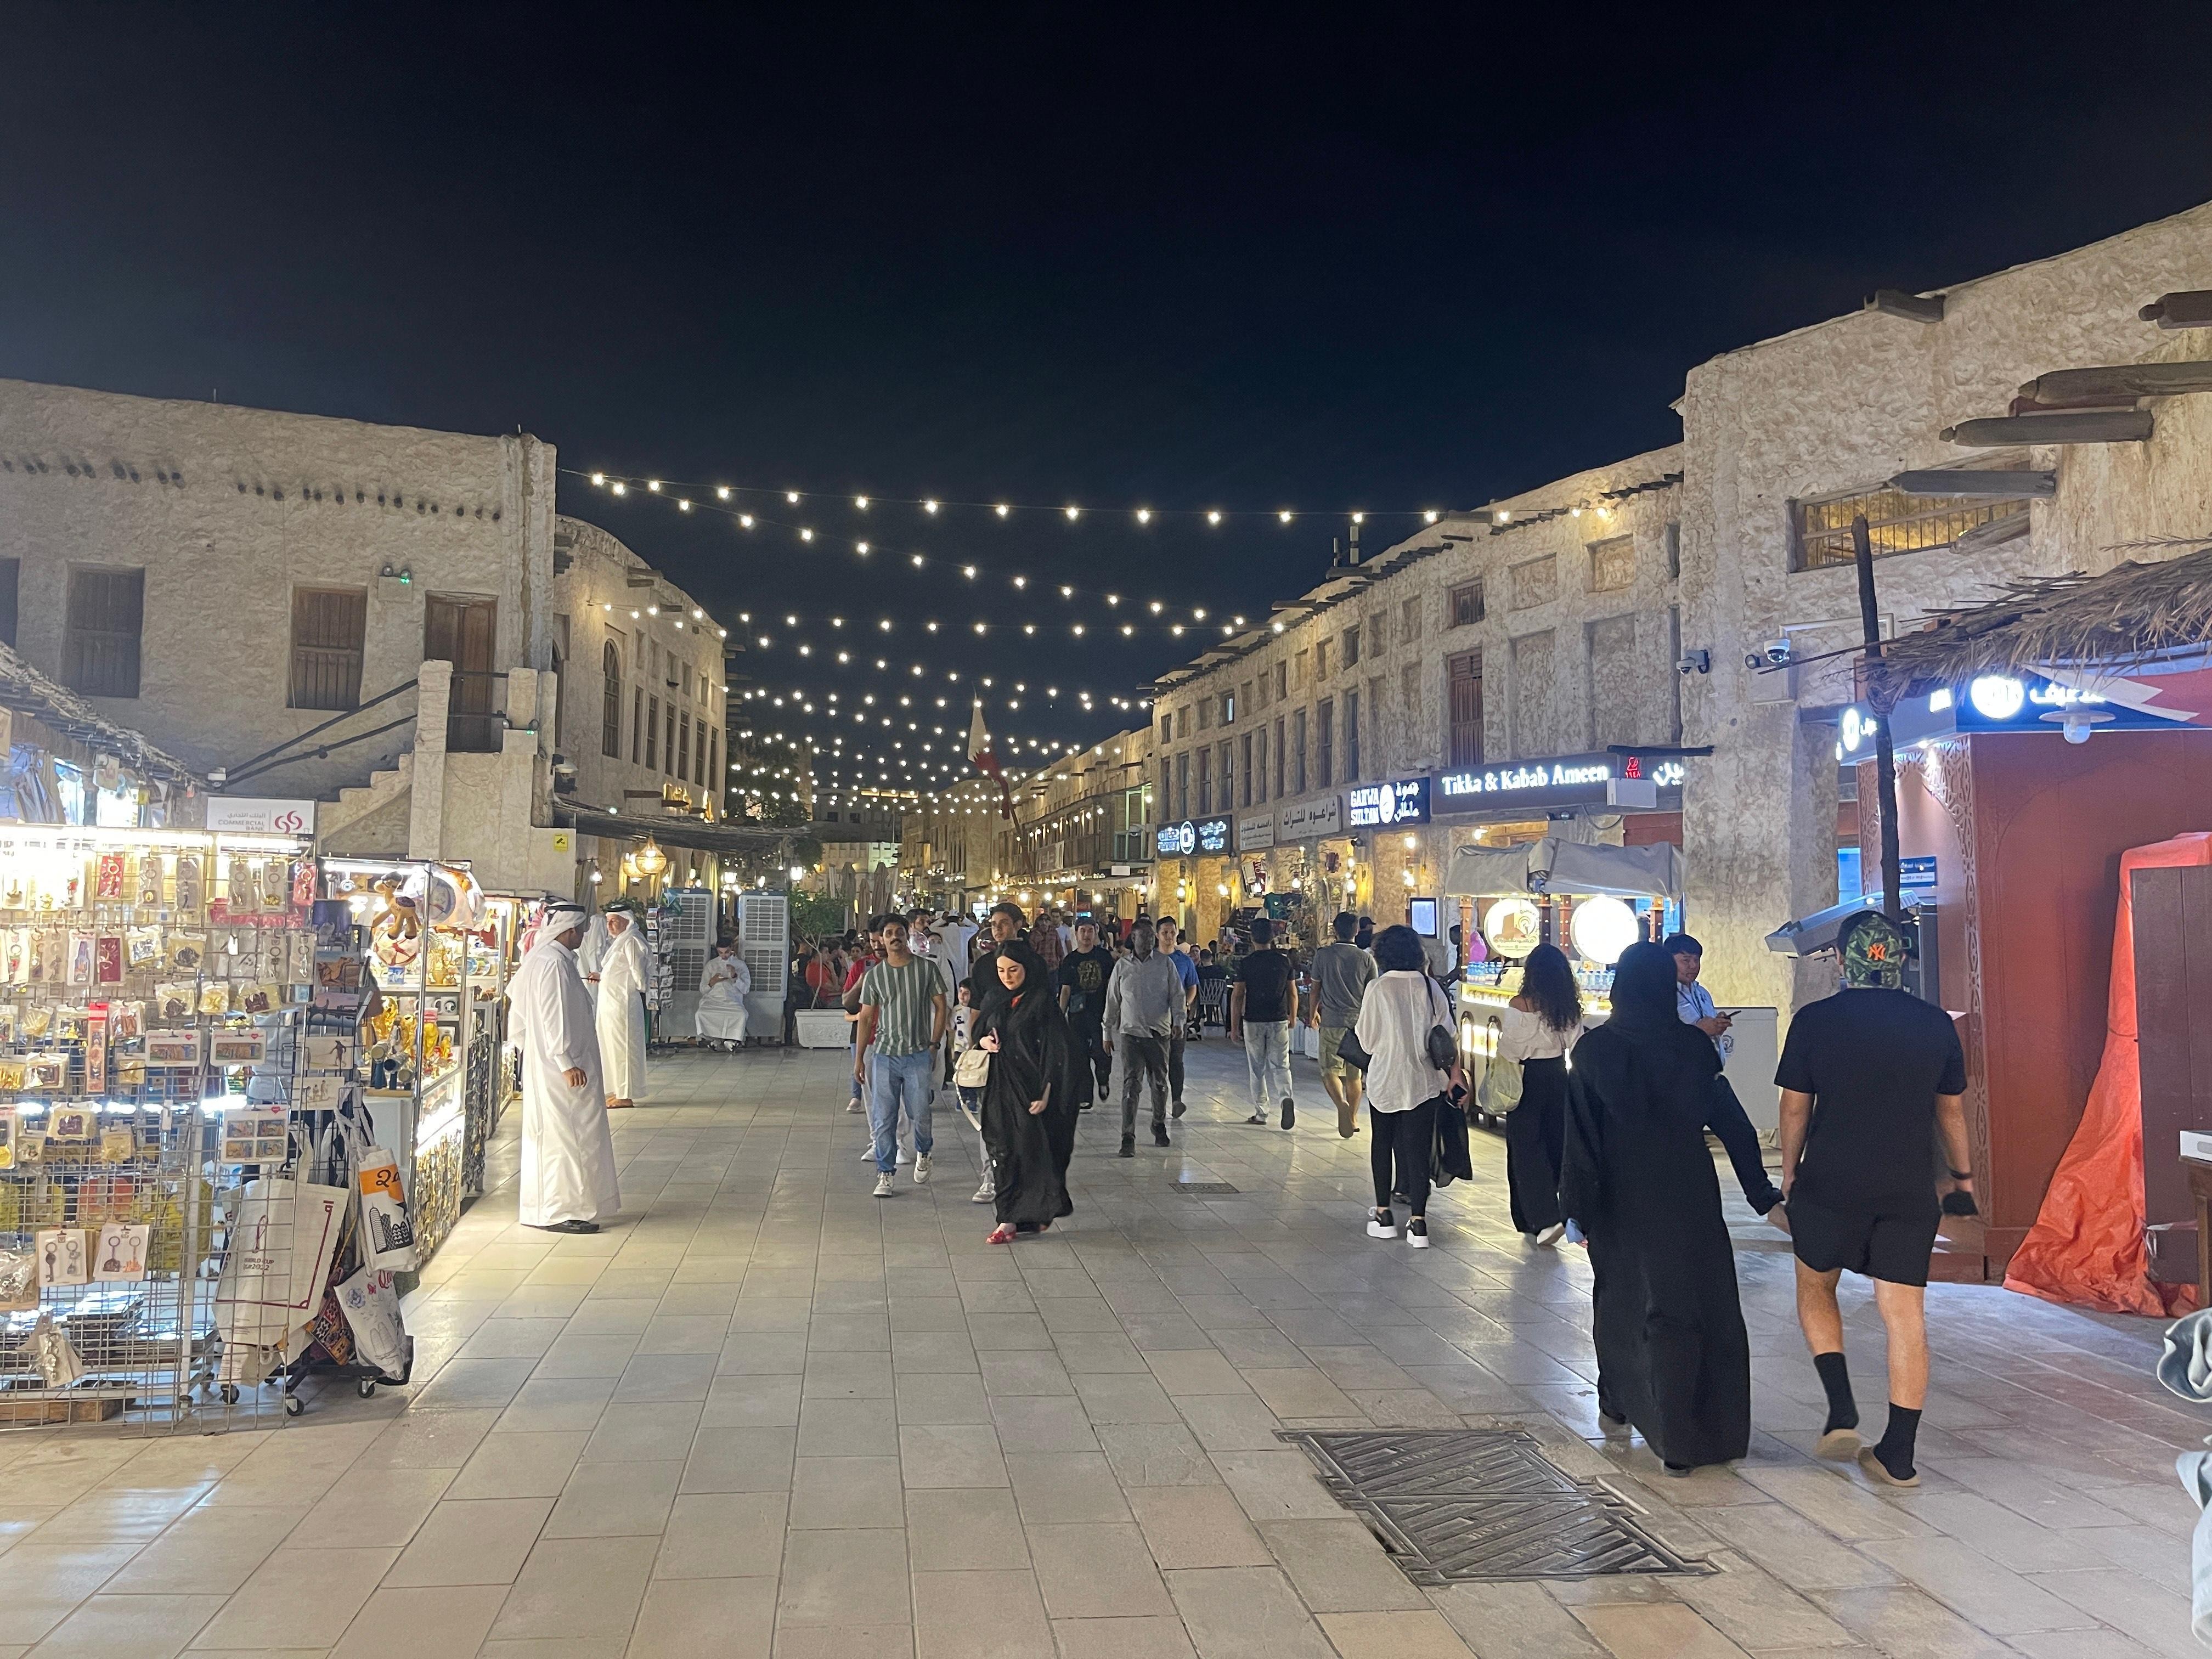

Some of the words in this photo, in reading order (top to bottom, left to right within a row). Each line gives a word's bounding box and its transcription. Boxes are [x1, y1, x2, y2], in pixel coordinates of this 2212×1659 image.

[1442, 775, 1482, 795] Tikka
[1485, 773, 1498, 791] &
[1500, 766, 1548, 790] Kabab
[1551, 764, 1609, 785] Ameen
[1351, 806, 1380, 826] SULTAN
